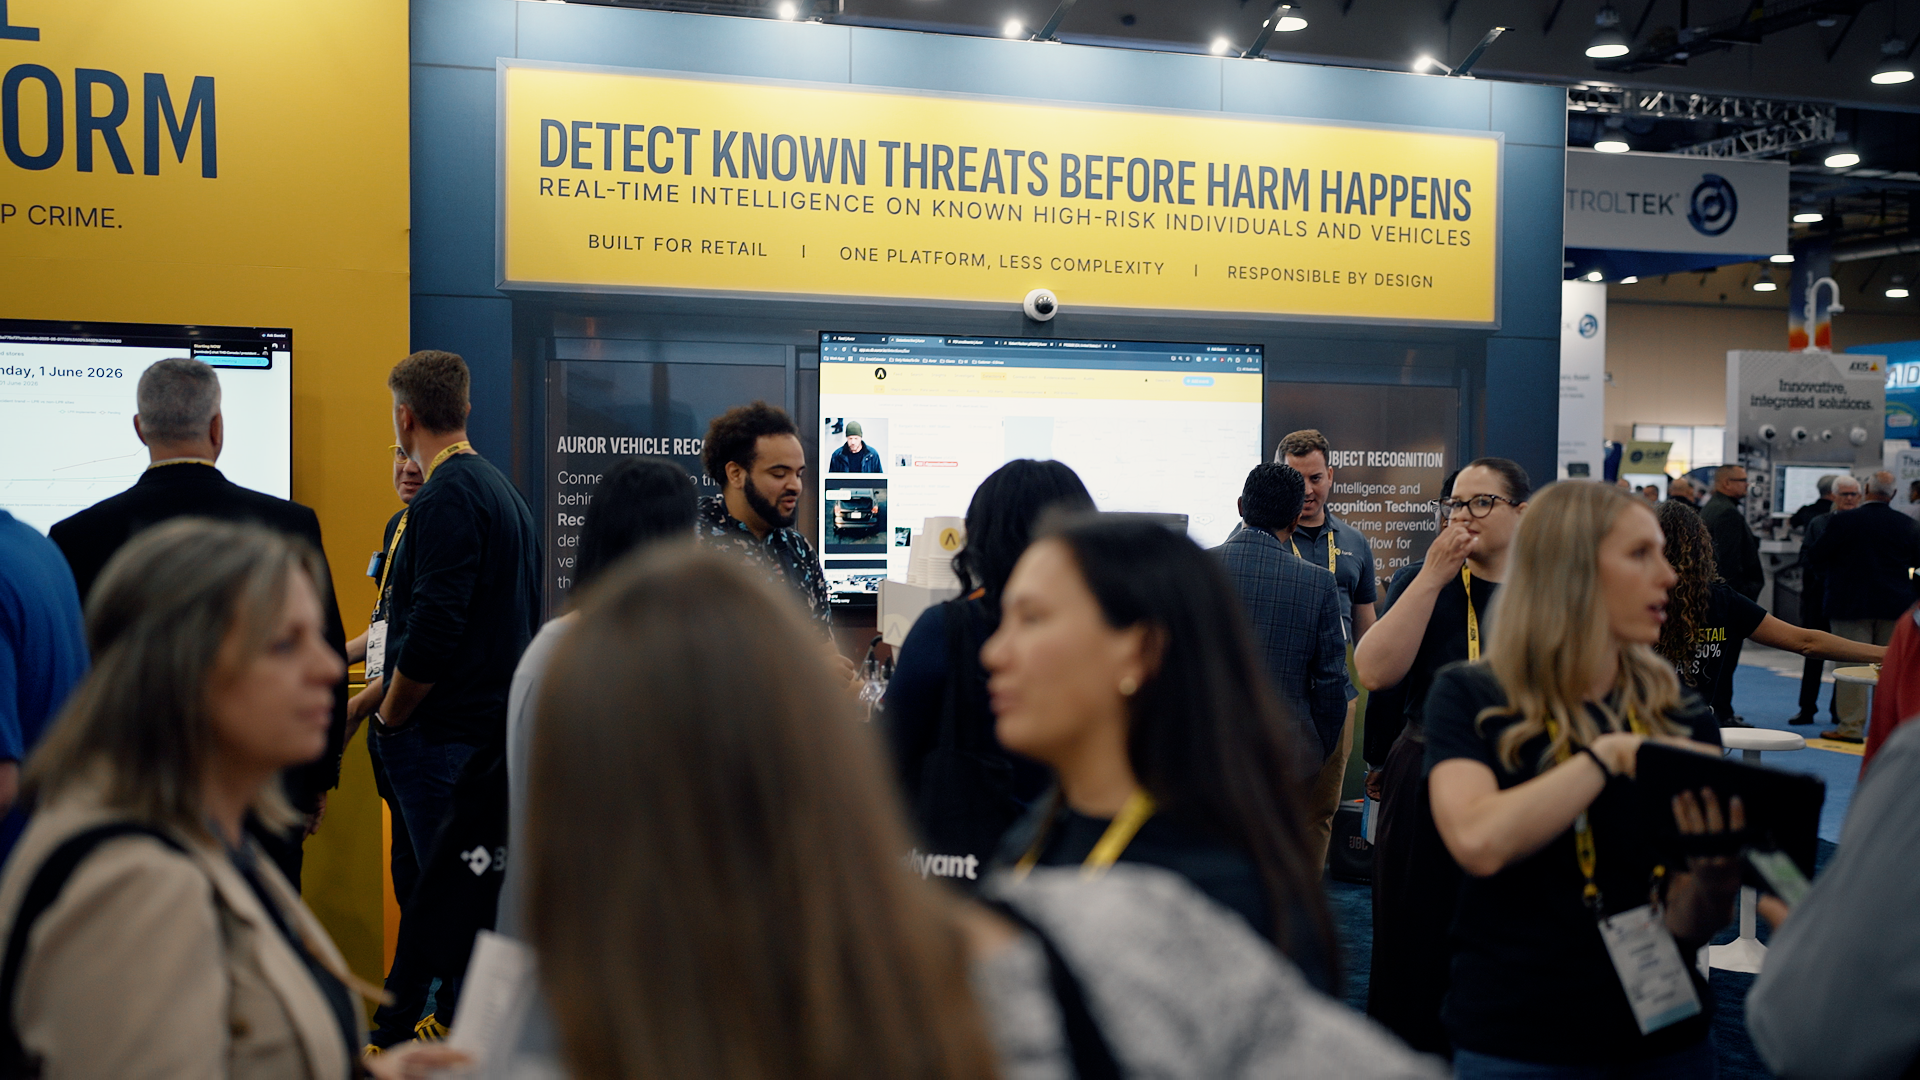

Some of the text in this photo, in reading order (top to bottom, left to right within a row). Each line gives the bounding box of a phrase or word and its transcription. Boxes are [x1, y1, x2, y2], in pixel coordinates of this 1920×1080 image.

[540, 119, 1471, 223] DETECT KNOWN THREATS BEFORE HARM HAPPENS
[28, 204, 123, 229] CRIME.
[540, 177, 1471, 247] REAL-TIME INTELLIGENCE ON KNOWN HIGH-RISK INDIVIDUALS AND VEHICLES
[588, 234, 768, 257] BUILT FOR RETAIL
[839, 246, 1165, 276] ONE PLATFORM, LESS COMPLEXITY
[1227, 265, 1433, 289] RESPONSIBLE BY DESIGN
[39, 366, 45, 376] 1
[49, 366, 83, 378] June
[87, 367, 123, 379] 2026
[557, 435, 705, 455] AUROR VEHICLE REC
[1367, 451, 1443, 468] RECOGNITION
[1333, 481, 1421, 497] Intelligence and
[1350, 518, 1382, 532] crime
[1367, 536, 1412, 549] flow for
[1388, 555, 1410, 567] and
[1349, 835, 1368, 850] JBL
